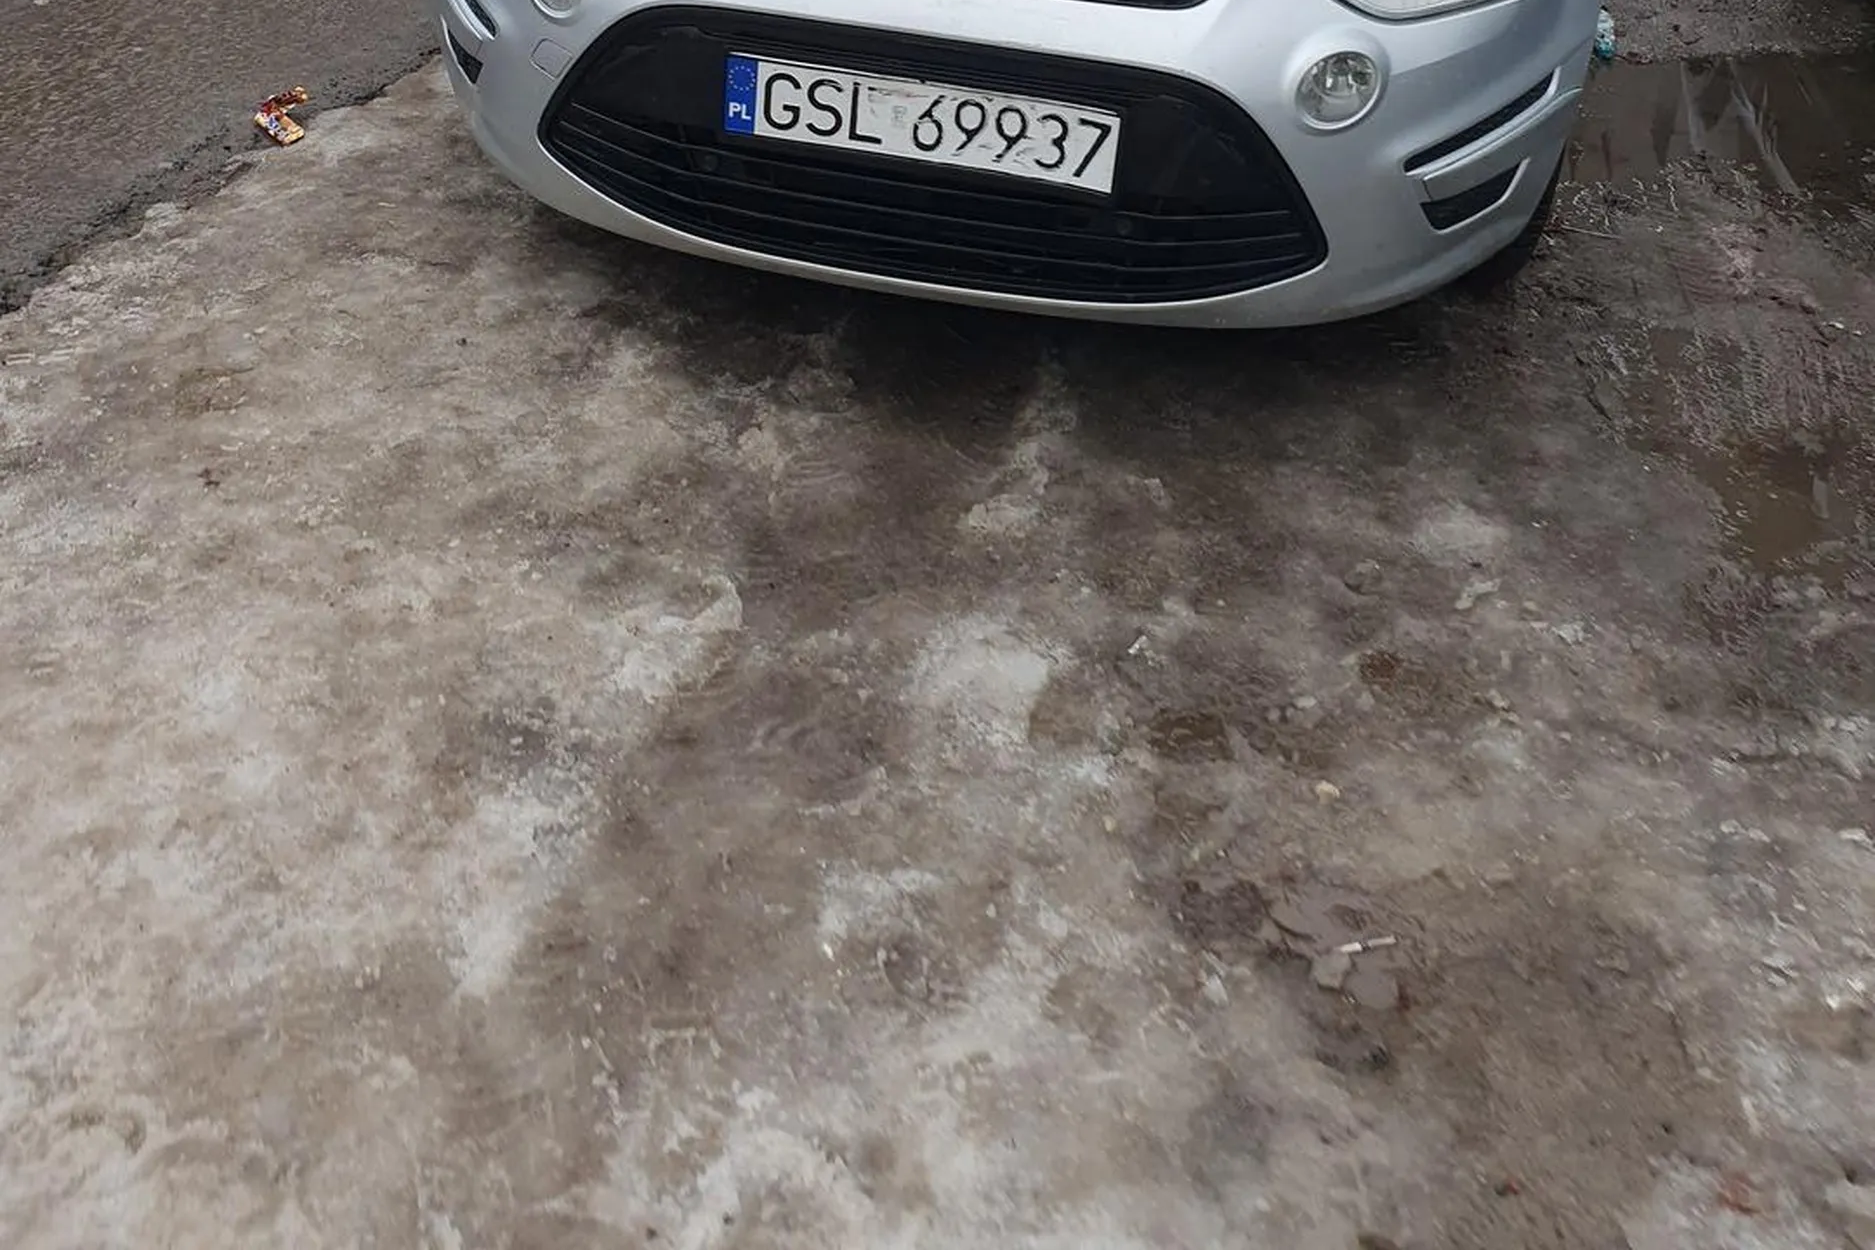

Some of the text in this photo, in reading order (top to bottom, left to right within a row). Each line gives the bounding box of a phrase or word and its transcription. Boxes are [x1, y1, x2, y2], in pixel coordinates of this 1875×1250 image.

[728, 101, 752, 121] PL
[762, 71, 1112, 179] GSL 69937
